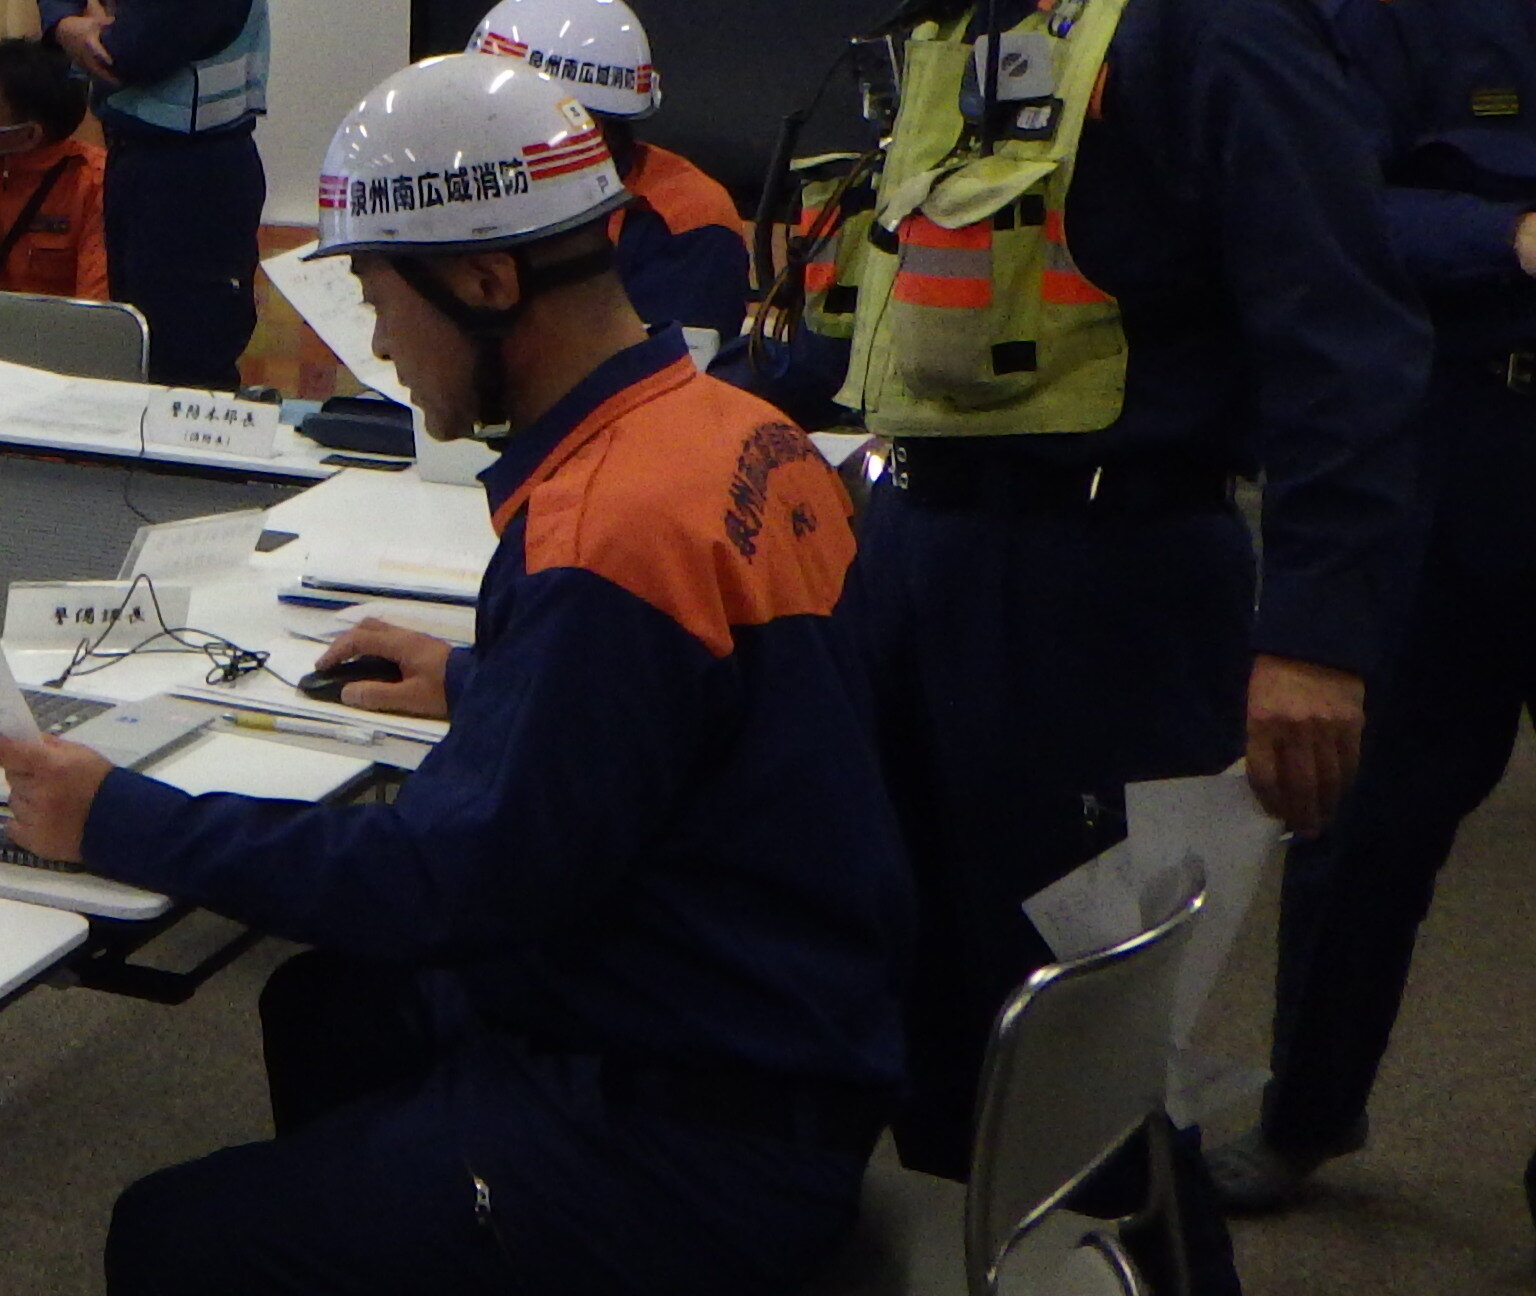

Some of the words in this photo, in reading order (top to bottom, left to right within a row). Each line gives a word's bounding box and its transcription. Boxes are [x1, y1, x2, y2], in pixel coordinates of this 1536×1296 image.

[350, 157, 529, 217] 泉州南広域消防
